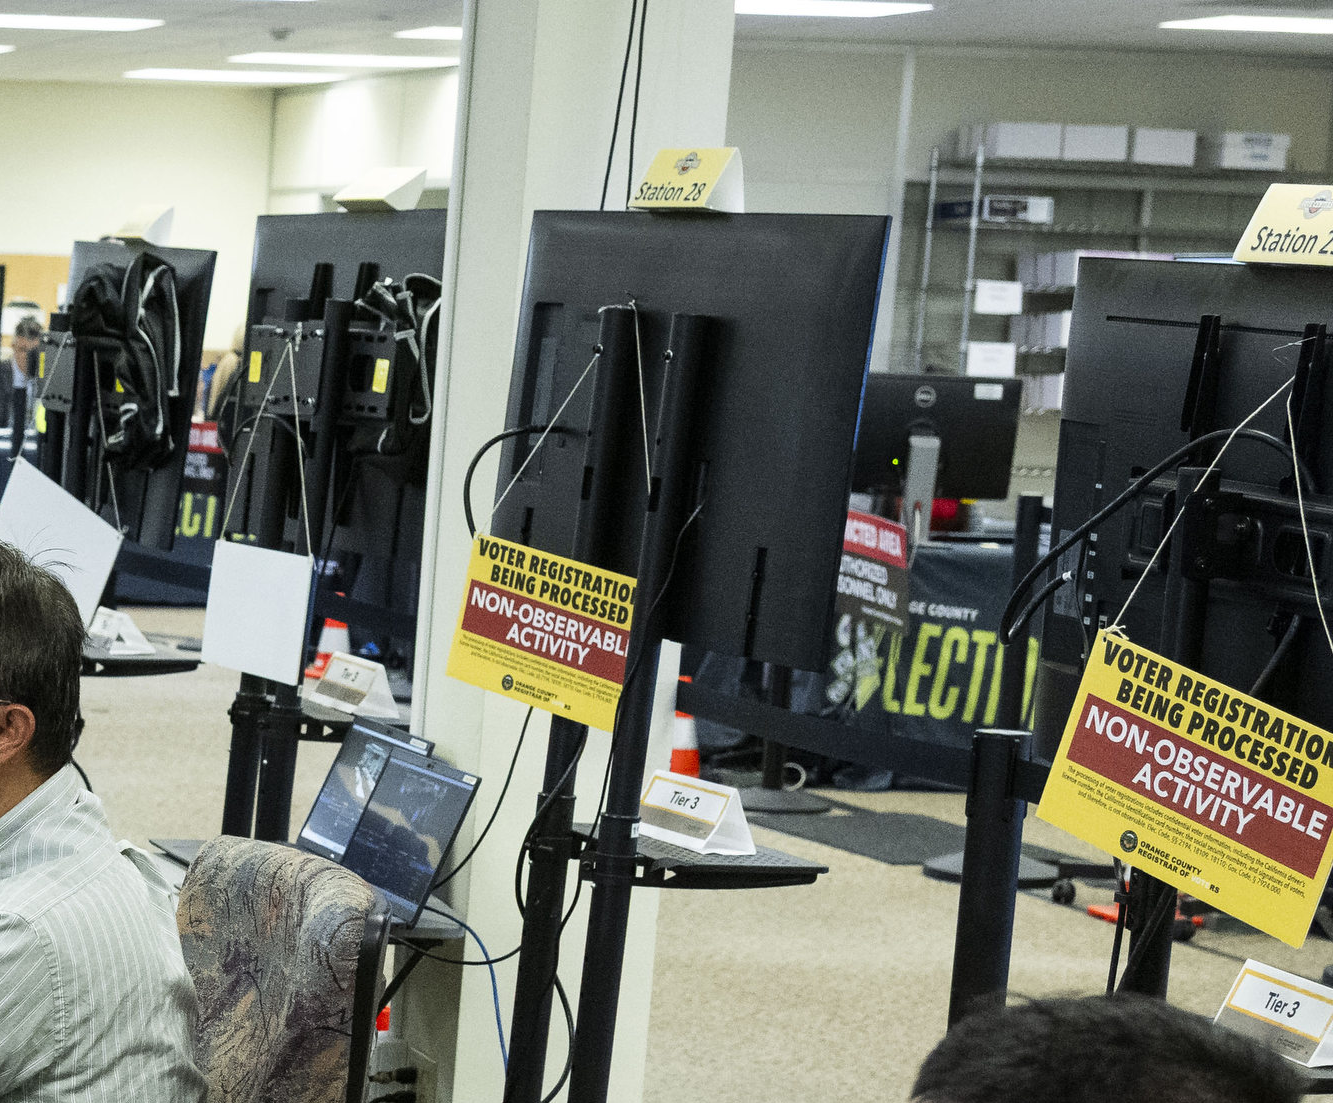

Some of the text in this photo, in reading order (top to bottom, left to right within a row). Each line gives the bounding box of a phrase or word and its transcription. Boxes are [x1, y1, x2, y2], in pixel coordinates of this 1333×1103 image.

[635, 182, 706, 201] Station 28
[1251, 226, 1333, 255] Station 2
[480, 538, 526, 569] VOTER
[491, 565, 629, 625] BEING PROCESSED
[506, 623, 591, 665] ACTIVITY
[1103, 640, 1173, 689] VOTER
[1116, 680, 1319, 789] BEING PROCESSED
[1084, 704, 1328, 841] NON-OBSERVABLE
[670, 791, 700, 809] Tier 3
[1132, 762, 1255, 835] ACTIVITY
[1137, 848, 1178, 873] REGISTRAR
[1179, 869, 1190, 878] OF
[1140, 841, 1202, 876] ORANGE COUNTY
[1265, 991, 1300, 1018] Tier 3
